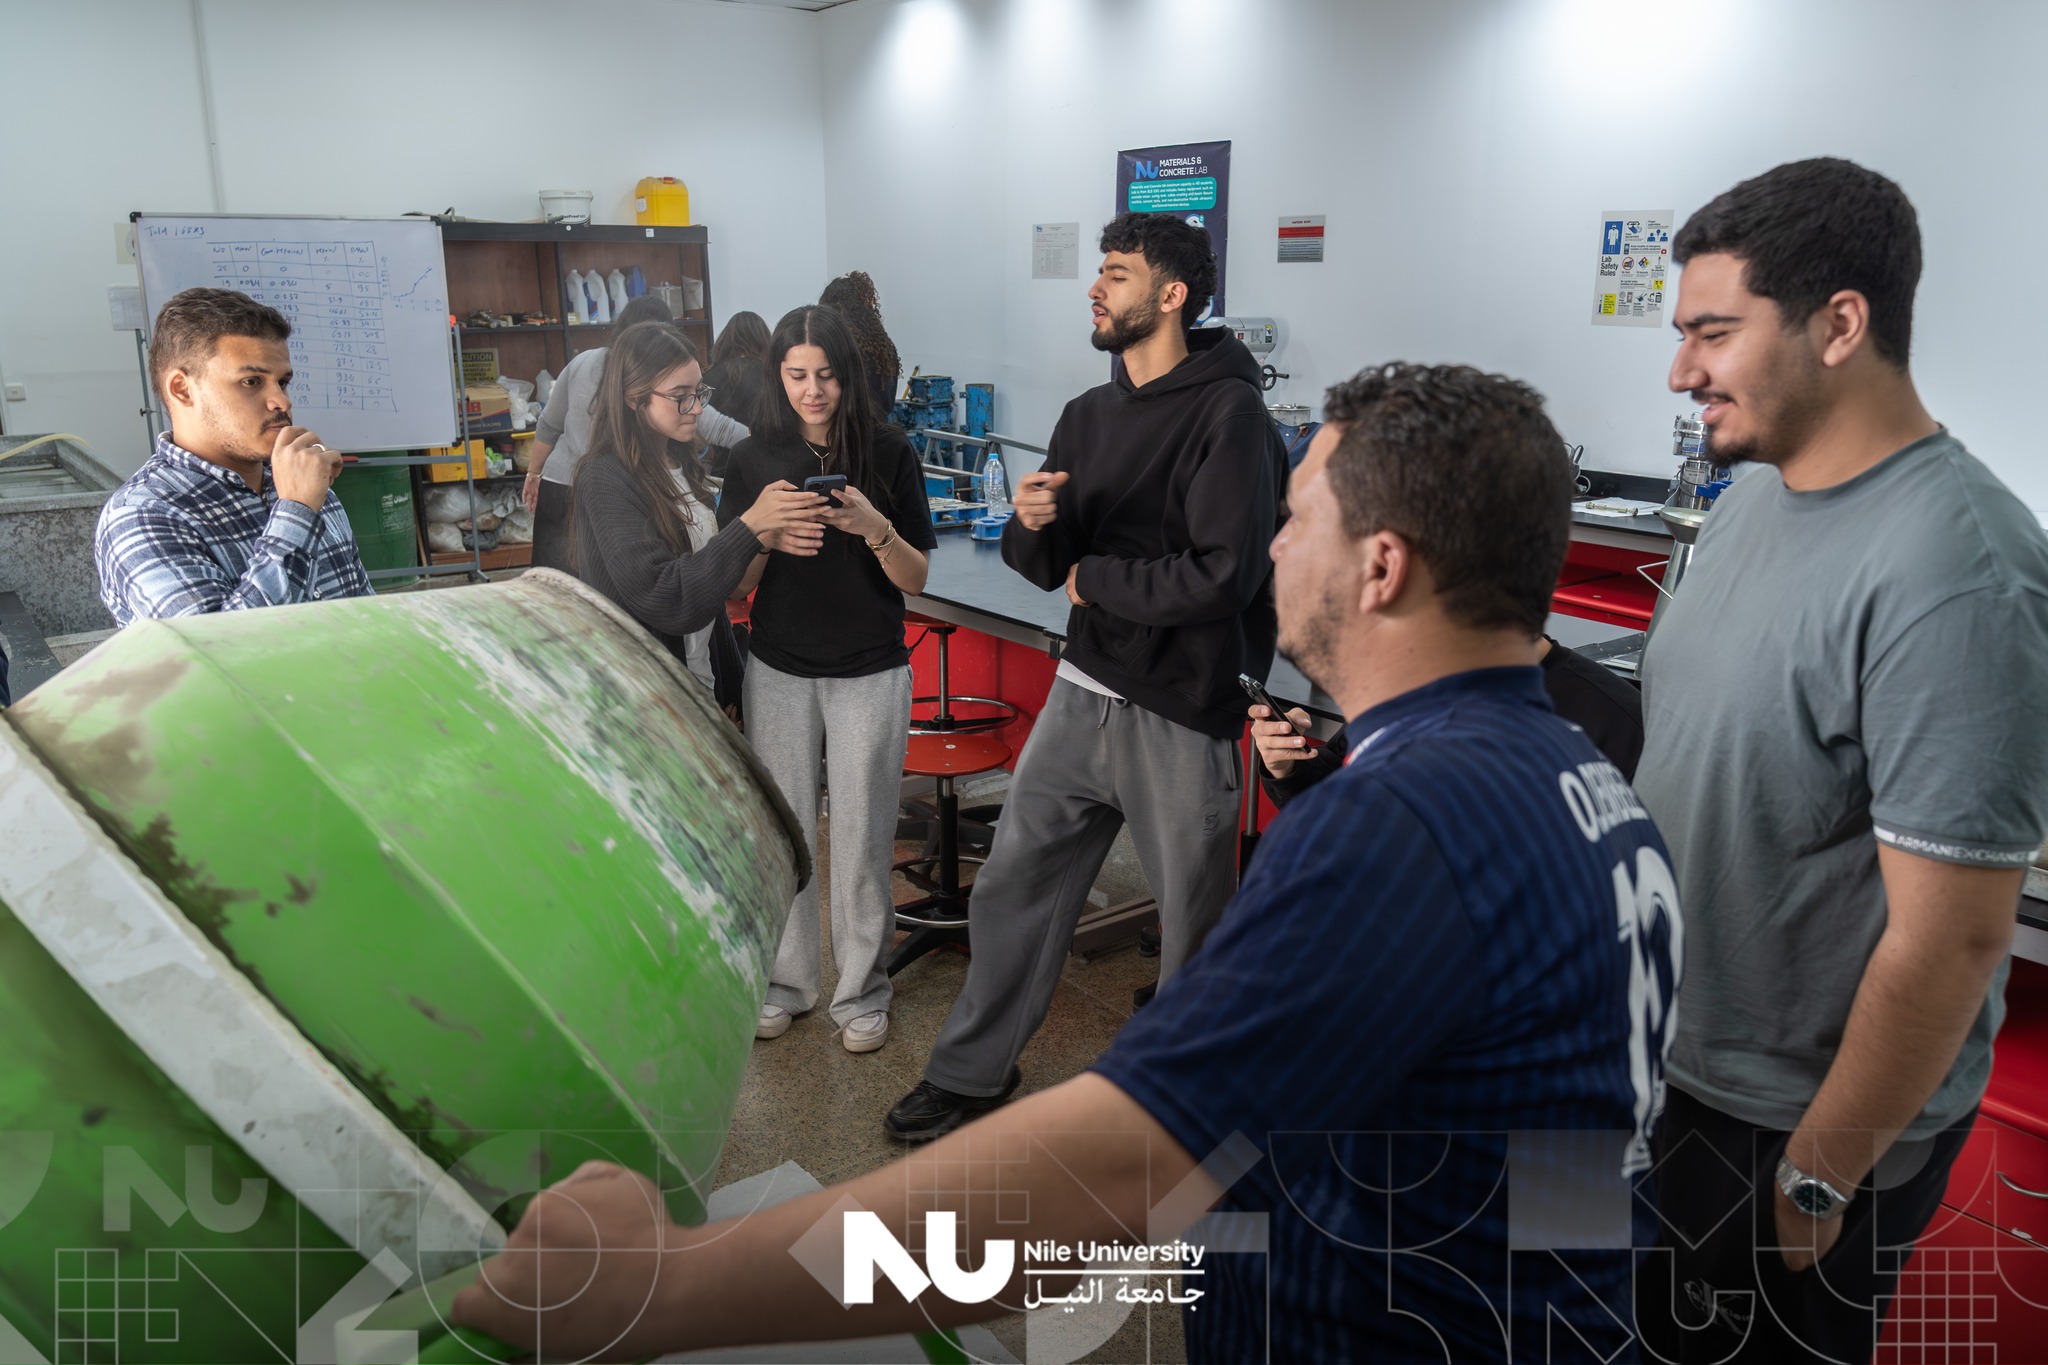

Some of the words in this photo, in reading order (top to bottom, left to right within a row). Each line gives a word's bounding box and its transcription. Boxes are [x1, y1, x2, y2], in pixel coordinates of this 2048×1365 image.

[1160, 158, 1196, 167] MATERIALS
[1197, 156, 1202, 164] &
[1136, 161, 1158, 180] NU
[1159, 167, 1194, 177] CONCRETE
[1195, 166, 1208, 174] LAB
[1600, 262, 1619, 270] Safety
